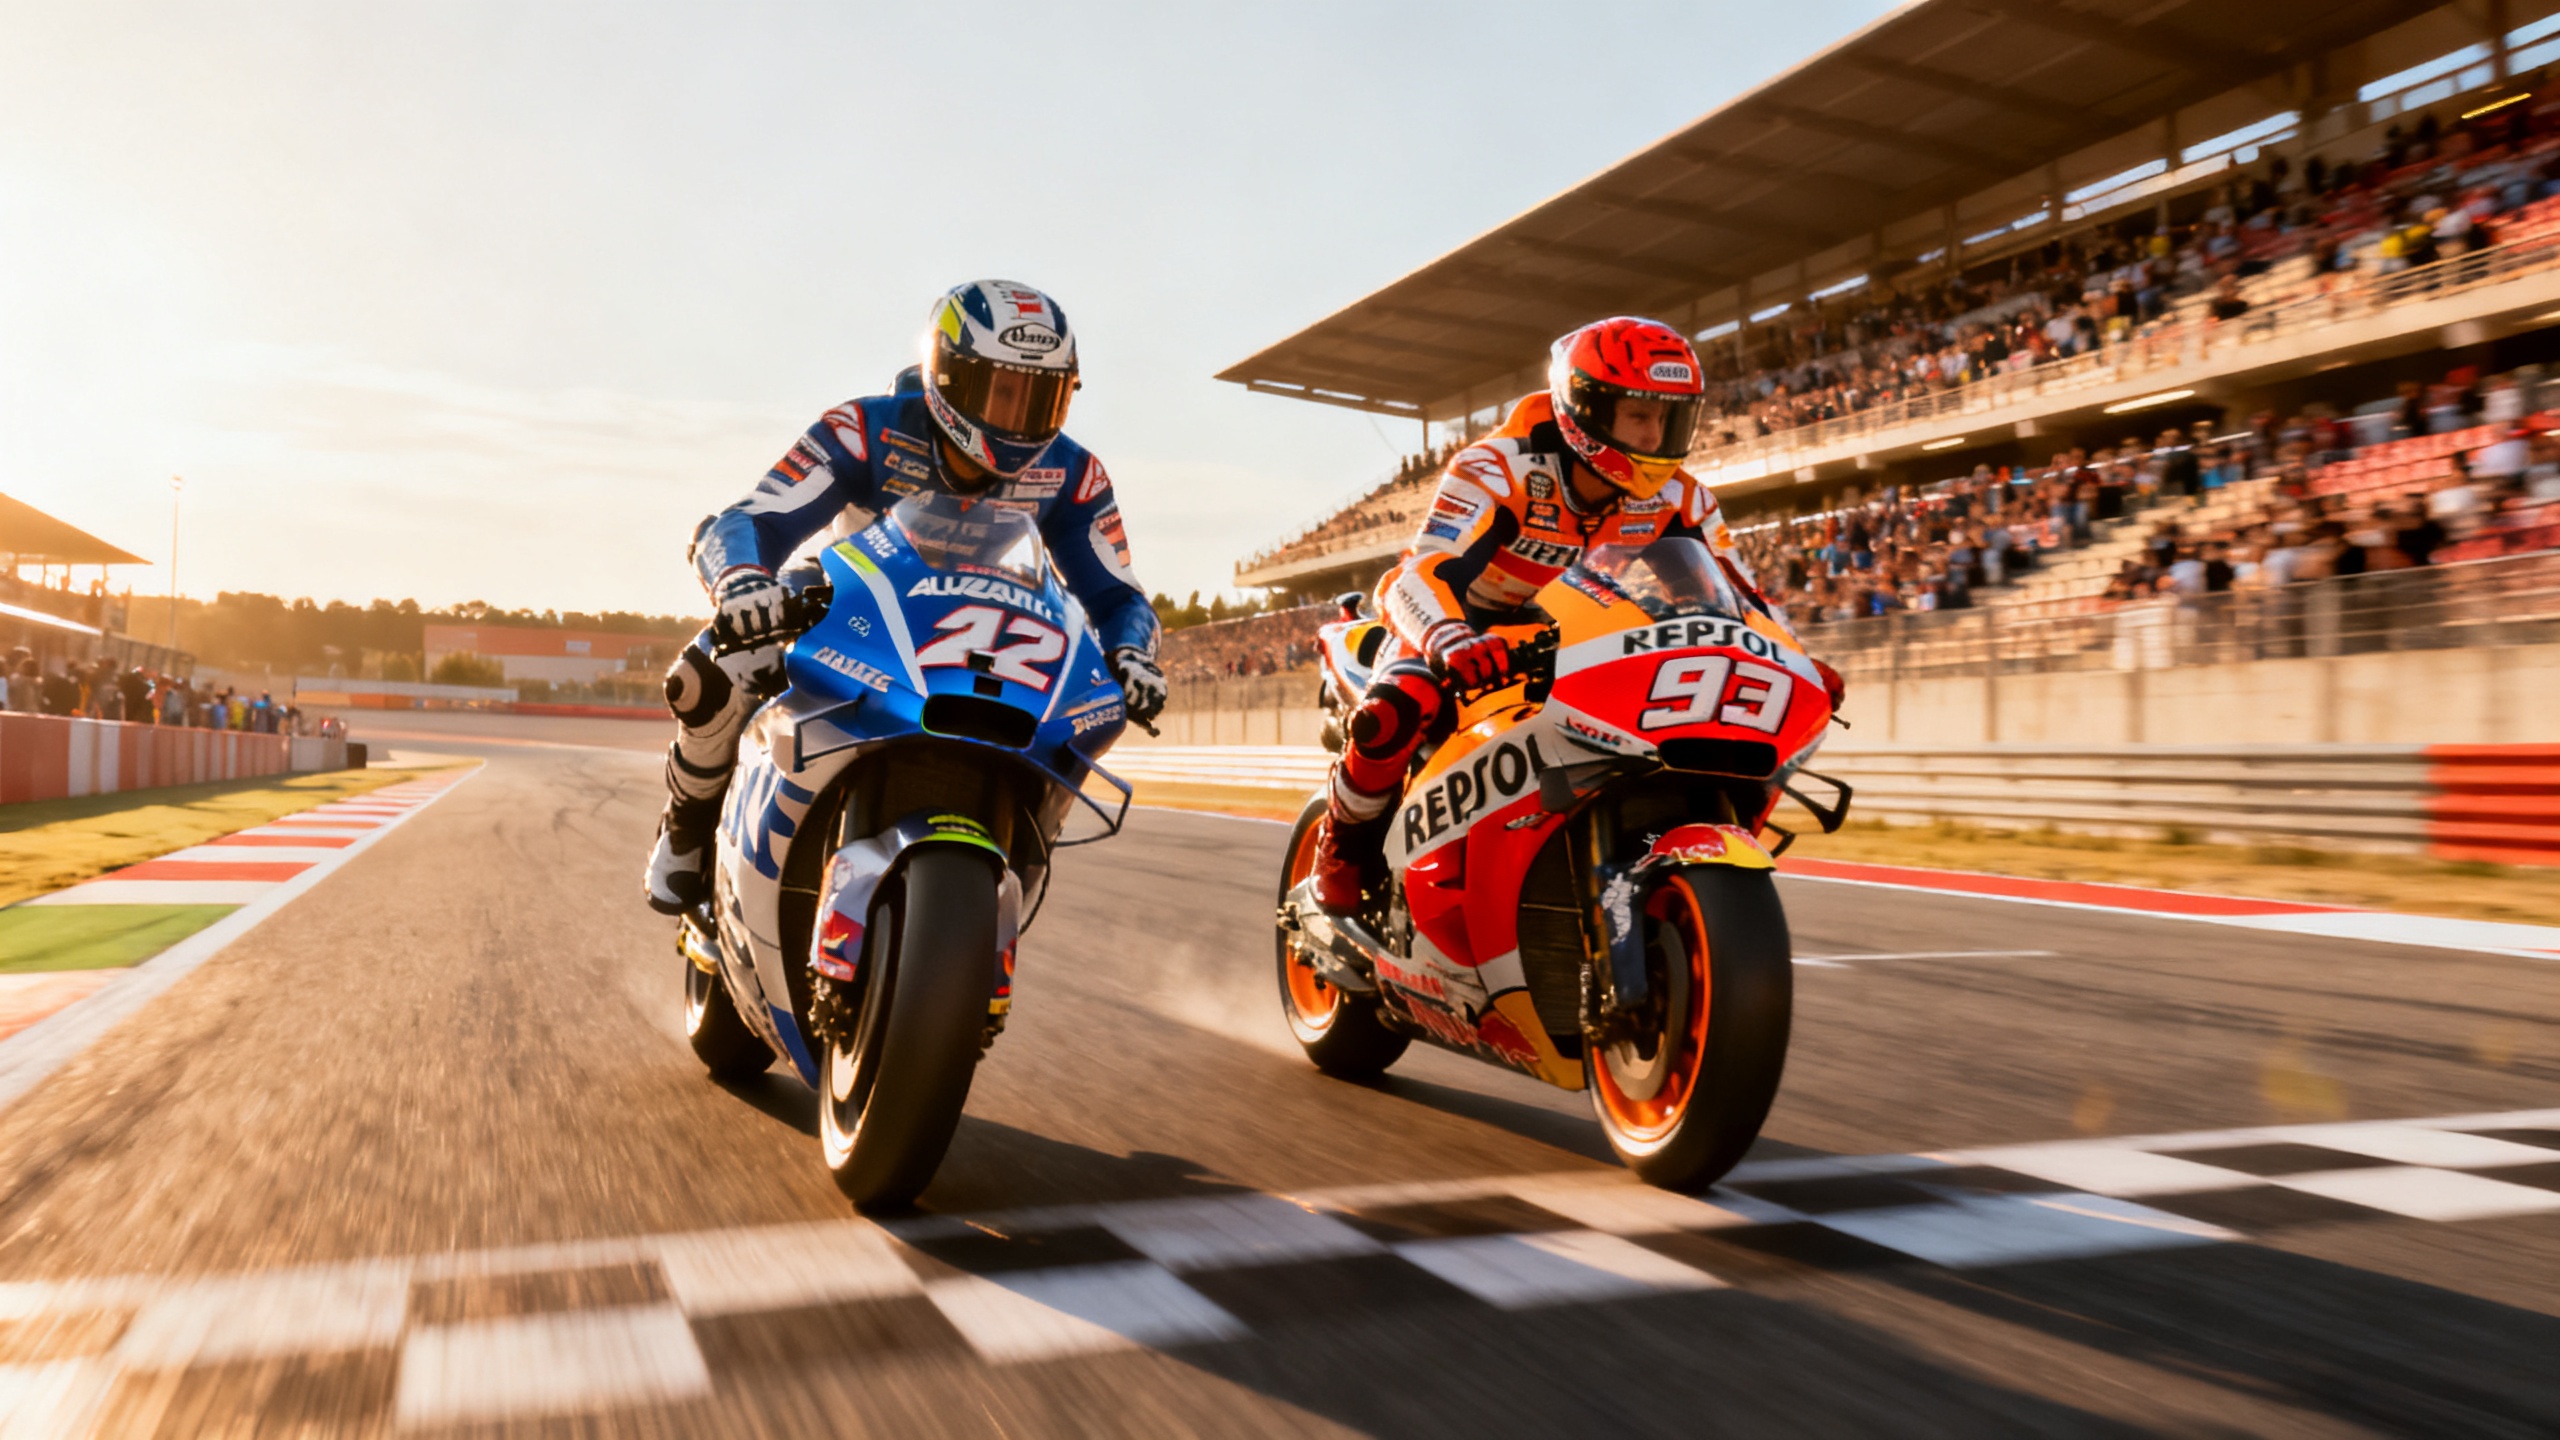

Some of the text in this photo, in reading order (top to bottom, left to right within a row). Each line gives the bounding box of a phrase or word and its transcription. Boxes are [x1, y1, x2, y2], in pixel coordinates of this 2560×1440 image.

[1622, 620, 1788, 665] REPSOL
[1637, 655, 1794, 736] 93
[1404, 733, 1549, 855] REPSOL
